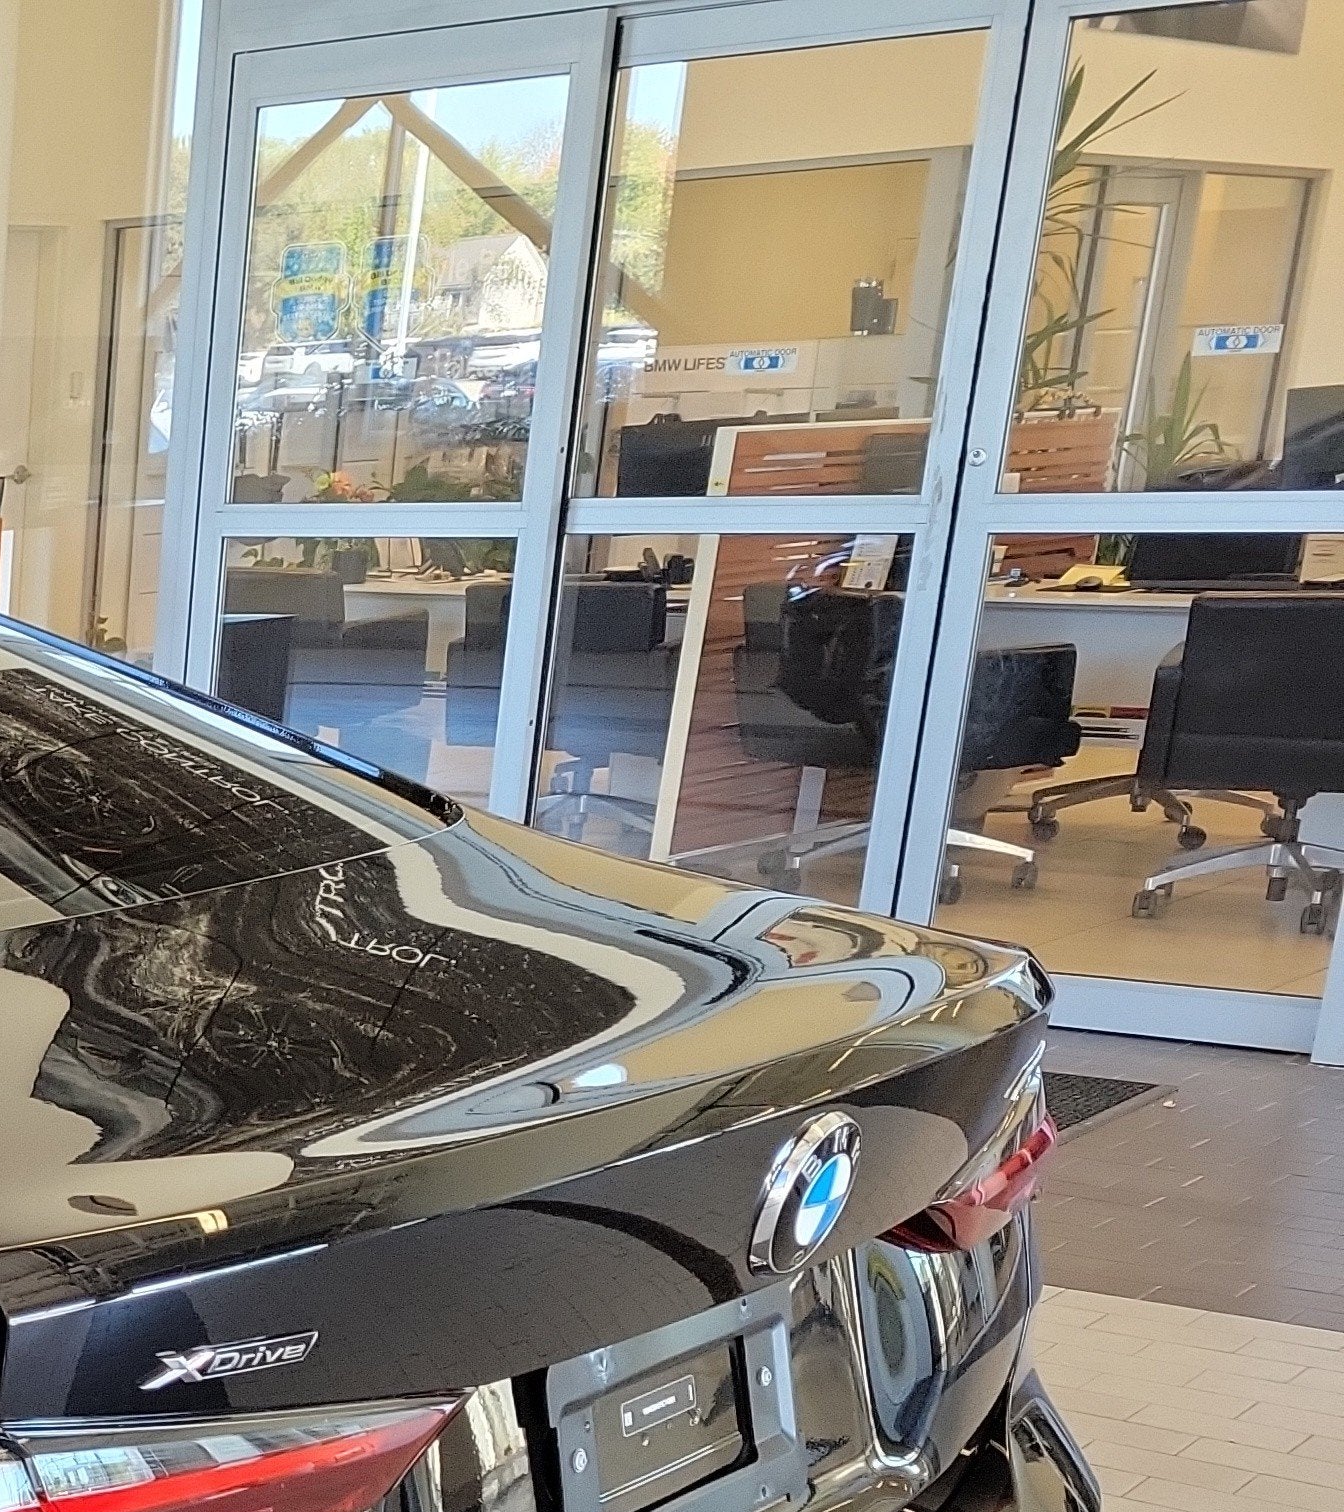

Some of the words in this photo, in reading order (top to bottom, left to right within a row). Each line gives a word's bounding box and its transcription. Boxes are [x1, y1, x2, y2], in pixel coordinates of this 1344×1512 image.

[1199, 326, 1251, 337] AUTOMATIC
[1253, 325, 1282, 334] DOOR
[729, 349, 773, 358] AUTOMATIC
[774, 347, 798, 356] DOOR
